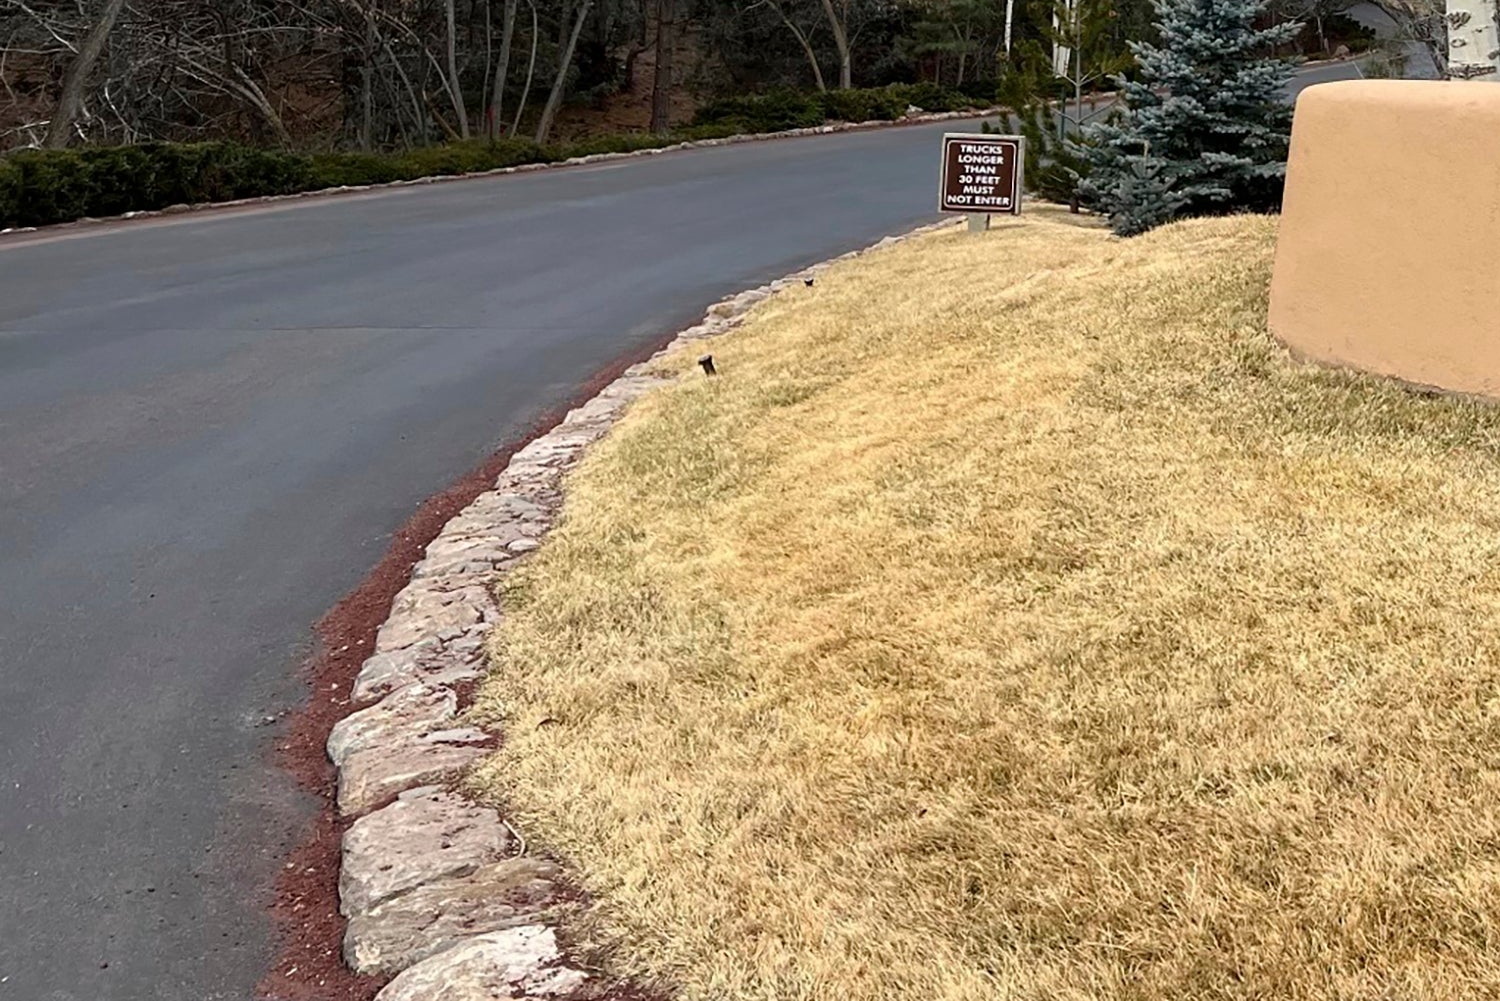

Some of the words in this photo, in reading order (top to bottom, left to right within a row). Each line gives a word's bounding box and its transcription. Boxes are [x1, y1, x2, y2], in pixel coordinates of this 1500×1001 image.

[960, 145, 1003, 154] TRUCKS
[958, 155, 1004, 164] LONGER
[964, 165, 996, 174] THAN
[958, 175, 973, 184] 30
[975, 175, 1001, 184] FEET
[963, 185, 995, 195] MUST
[947, 195, 973, 204] NOT
[974, 196, 1010, 206] ENTER
